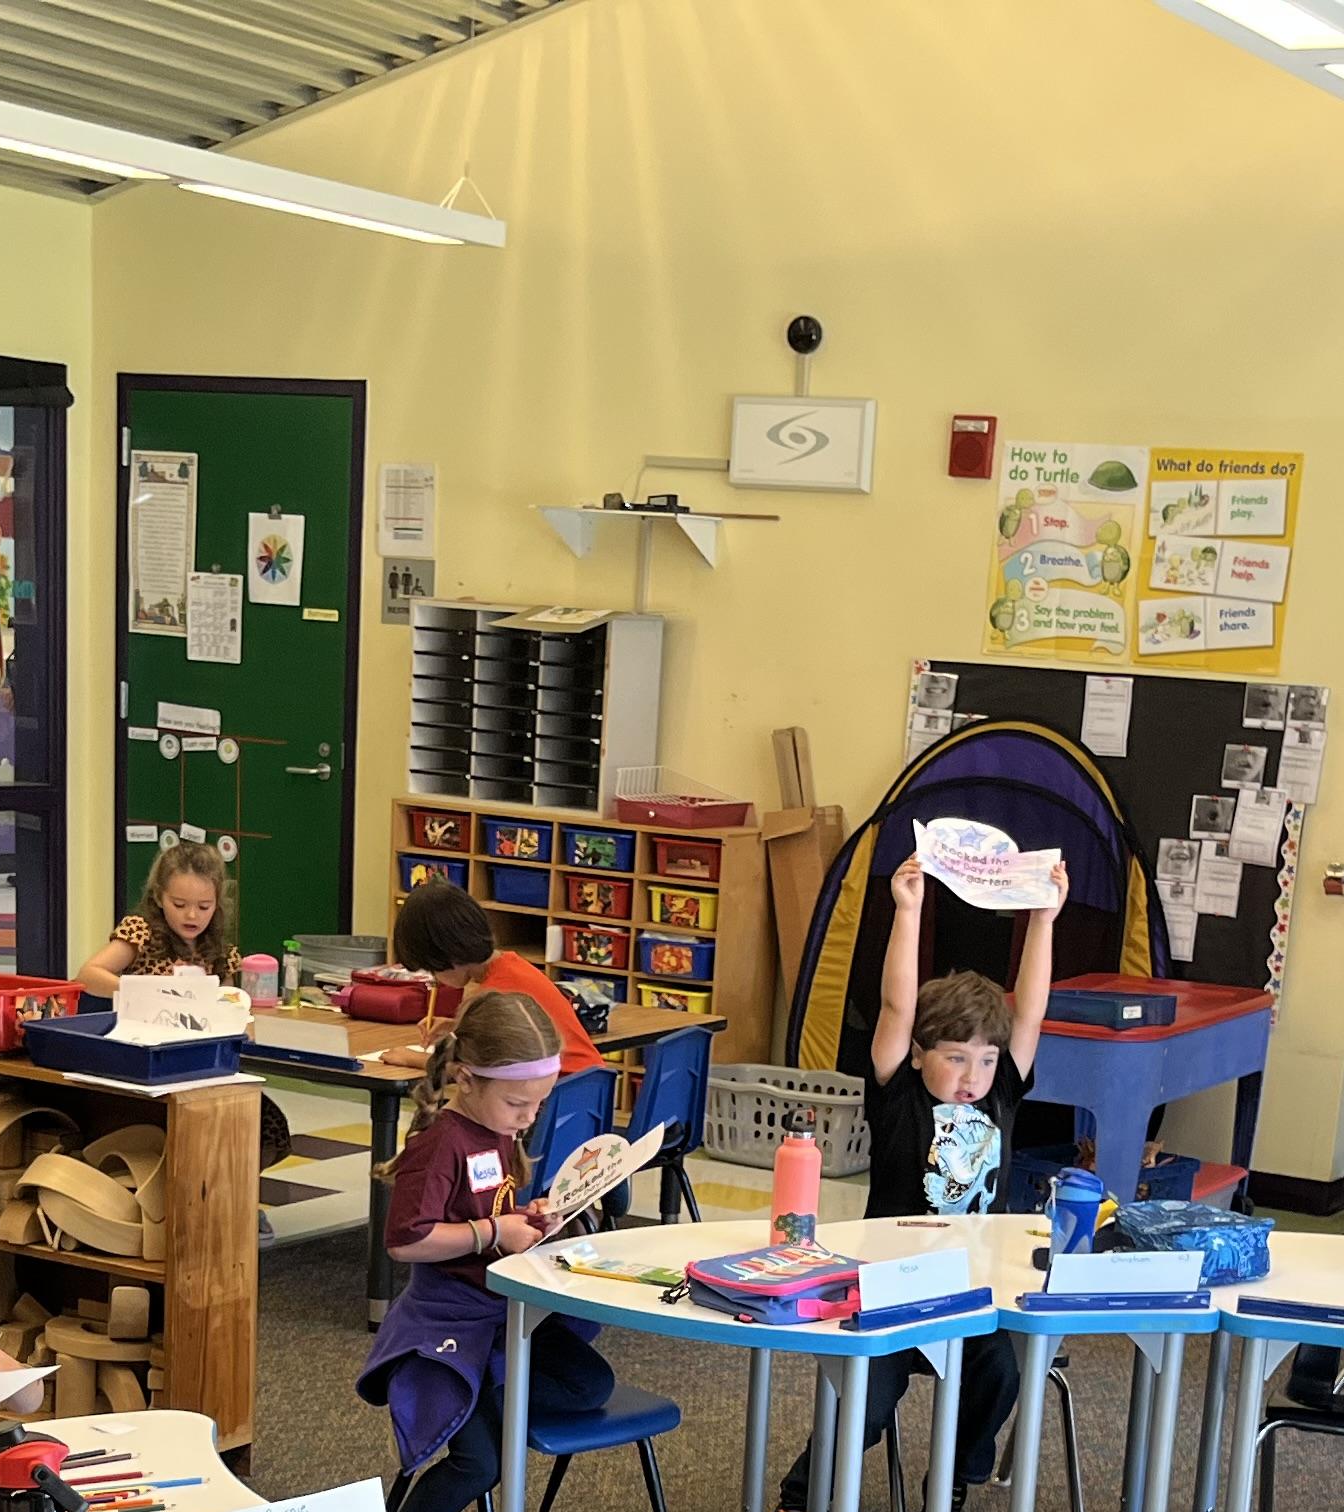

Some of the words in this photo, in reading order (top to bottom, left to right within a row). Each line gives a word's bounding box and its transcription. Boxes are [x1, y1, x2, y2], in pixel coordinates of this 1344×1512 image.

[1010, 446, 1047, 464] How
[1053, 448, 1068, 464] to
[1009, 465, 1029, 481] do
[1035, 466, 1080, 483] Turtle
[1156, 458, 1191, 473] What
[1196, 459, 1213, 473] do
[1218, 460, 1266, 475] friends
[1270, 462, 1296, 476] do?
[1042, 516, 1069, 530] Stop.
[1019, 551, 1036, 576] 2
[1039, 553, 1084, 568] Breathe.
[1231, 555, 1270, 570] Friends
[1016, 608, 1029, 632] 3
[1033, 604, 1052, 618] Say
[1072, 608, 1115, 622] problem
[1218, 607, 1256, 619] Friends
[1218, 621, 1250, 632] share.
[472, 1162, 498, 1180] Nessa
[563, 1167, 605, 1204] Rocked
